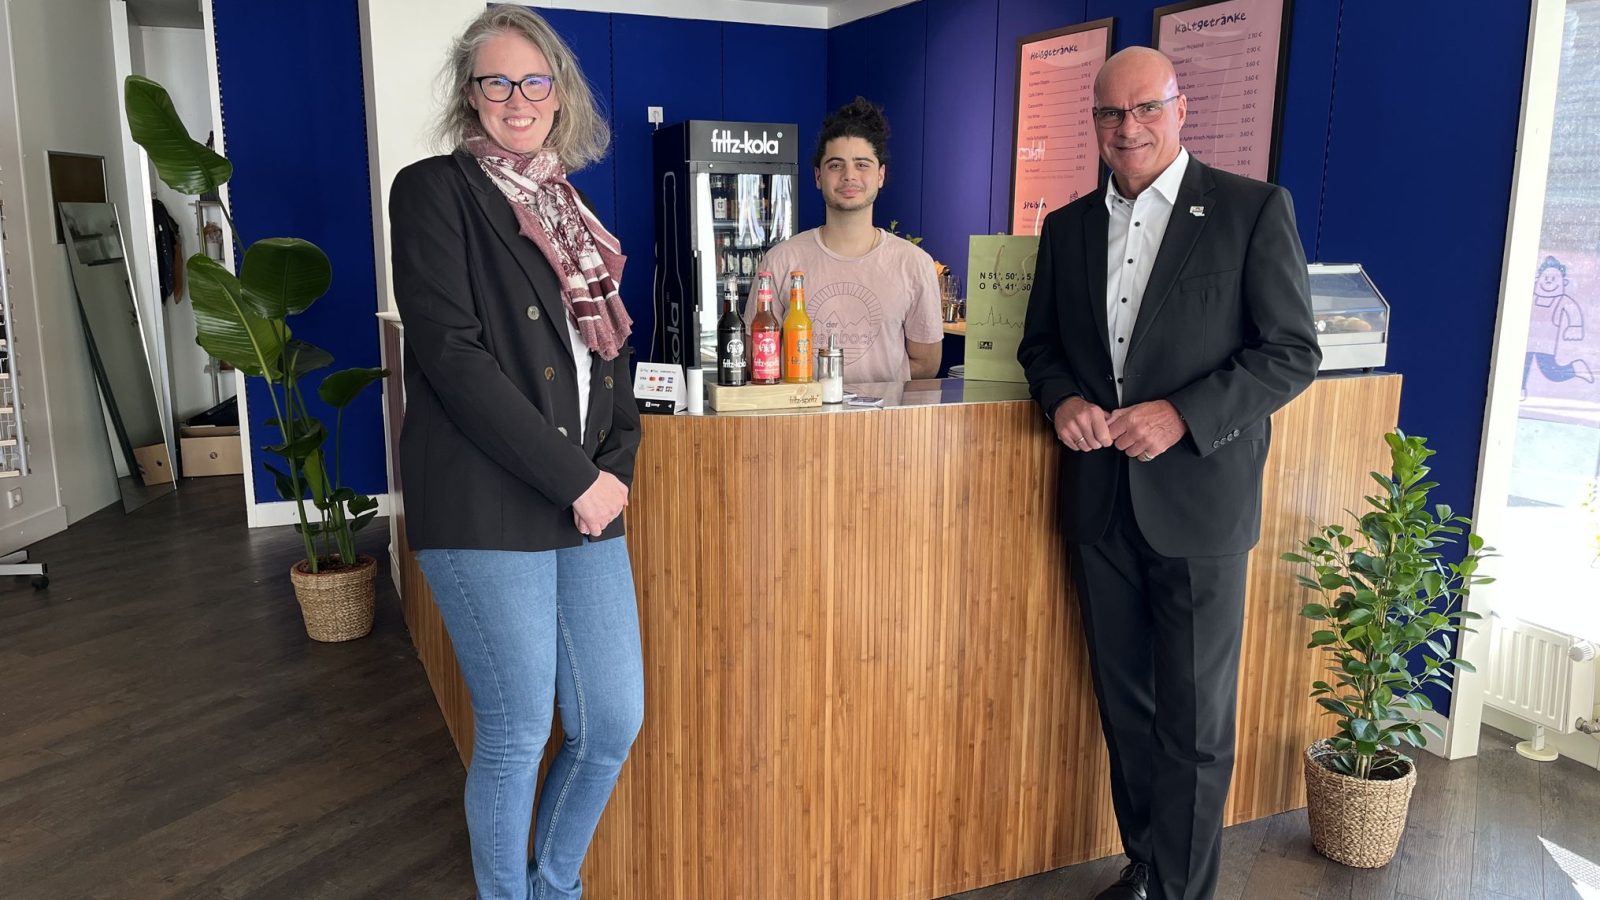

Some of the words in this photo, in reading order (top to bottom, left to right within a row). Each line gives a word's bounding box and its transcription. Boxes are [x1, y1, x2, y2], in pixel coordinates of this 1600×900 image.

[1175, 12, 1246, 34] Kaltgetränke
[1031, 45, 1078, 59] Heißgetränke
[711, 129, 778, 154] fritz-kola
[1023, 200, 1047, 210] Speisn
[980, 272, 986, 280] N
